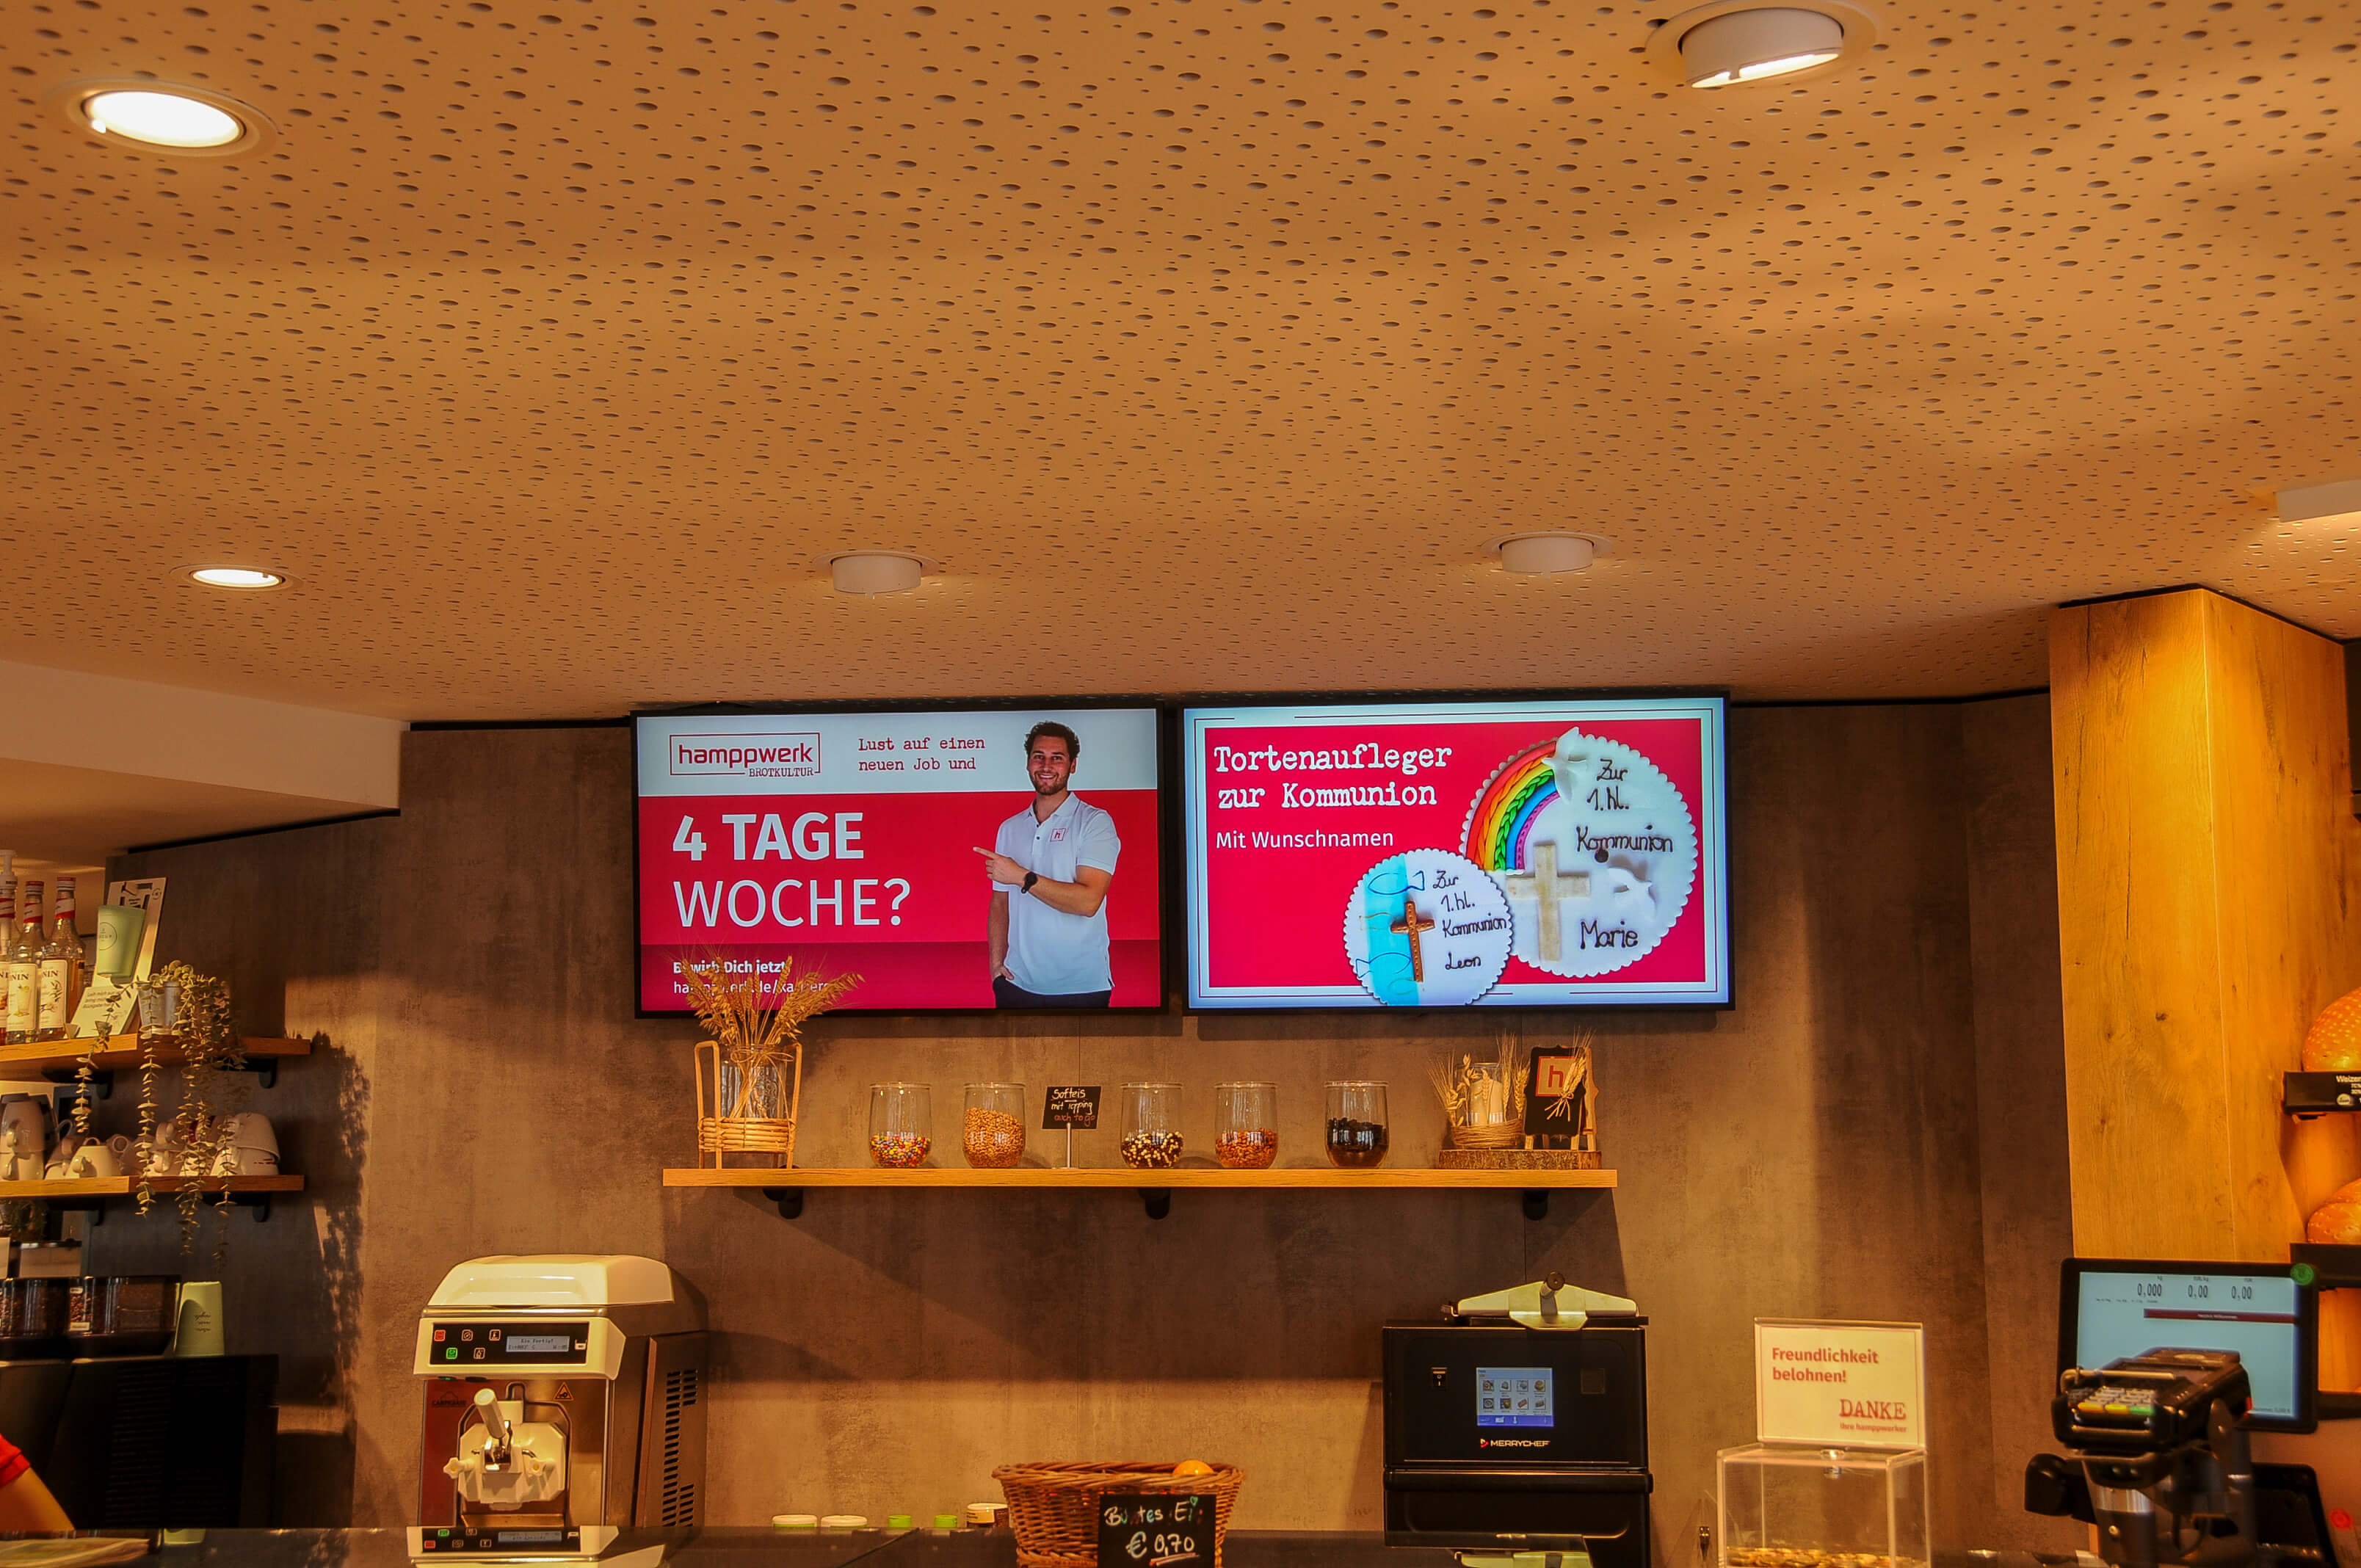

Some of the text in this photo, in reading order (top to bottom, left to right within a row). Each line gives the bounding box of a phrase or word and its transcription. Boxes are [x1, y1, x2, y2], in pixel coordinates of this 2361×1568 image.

[858, 737, 985, 751] Lust auf einen
[679, 743, 813, 769] hamppwerk
[858, 758, 976, 772] neuen Job und
[1214, 742, 1452, 774] Tortenaufleger
[748, 767, 813, 778] BROTKULTUR
[1596, 758, 1628, 781] Zur
[1218, 781, 1437, 808] zur Kommunion
[672, 812, 864, 861] 4 TAGE
[1216, 830, 1393, 848] Mit Wunschnamen
[1576, 824, 1673, 852] Kommunion
[1433, 871, 1459, 889] Zur
[673, 878, 911, 927] WOCHE?
[1442, 912, 1506, 937] Kommunion
[1580, 920, 1639, 949] Marie
[724, 959, 752, 973] Dich
[1445, 952, 1481, 970] Leon
[1051, 1087, 1086, 1100] Softeis
[1051, 1101, 1064, 1110] mit
[1053, 1112, 1072, 1121] auch
[1772, 1347, 1879, 1364] Freundlichkeit
[1773, 1367, 1846, 1383] belohnen!
[1838, 1398, 1907, 1420] DANKE
[1125, 1531, 1147, 1558] €
